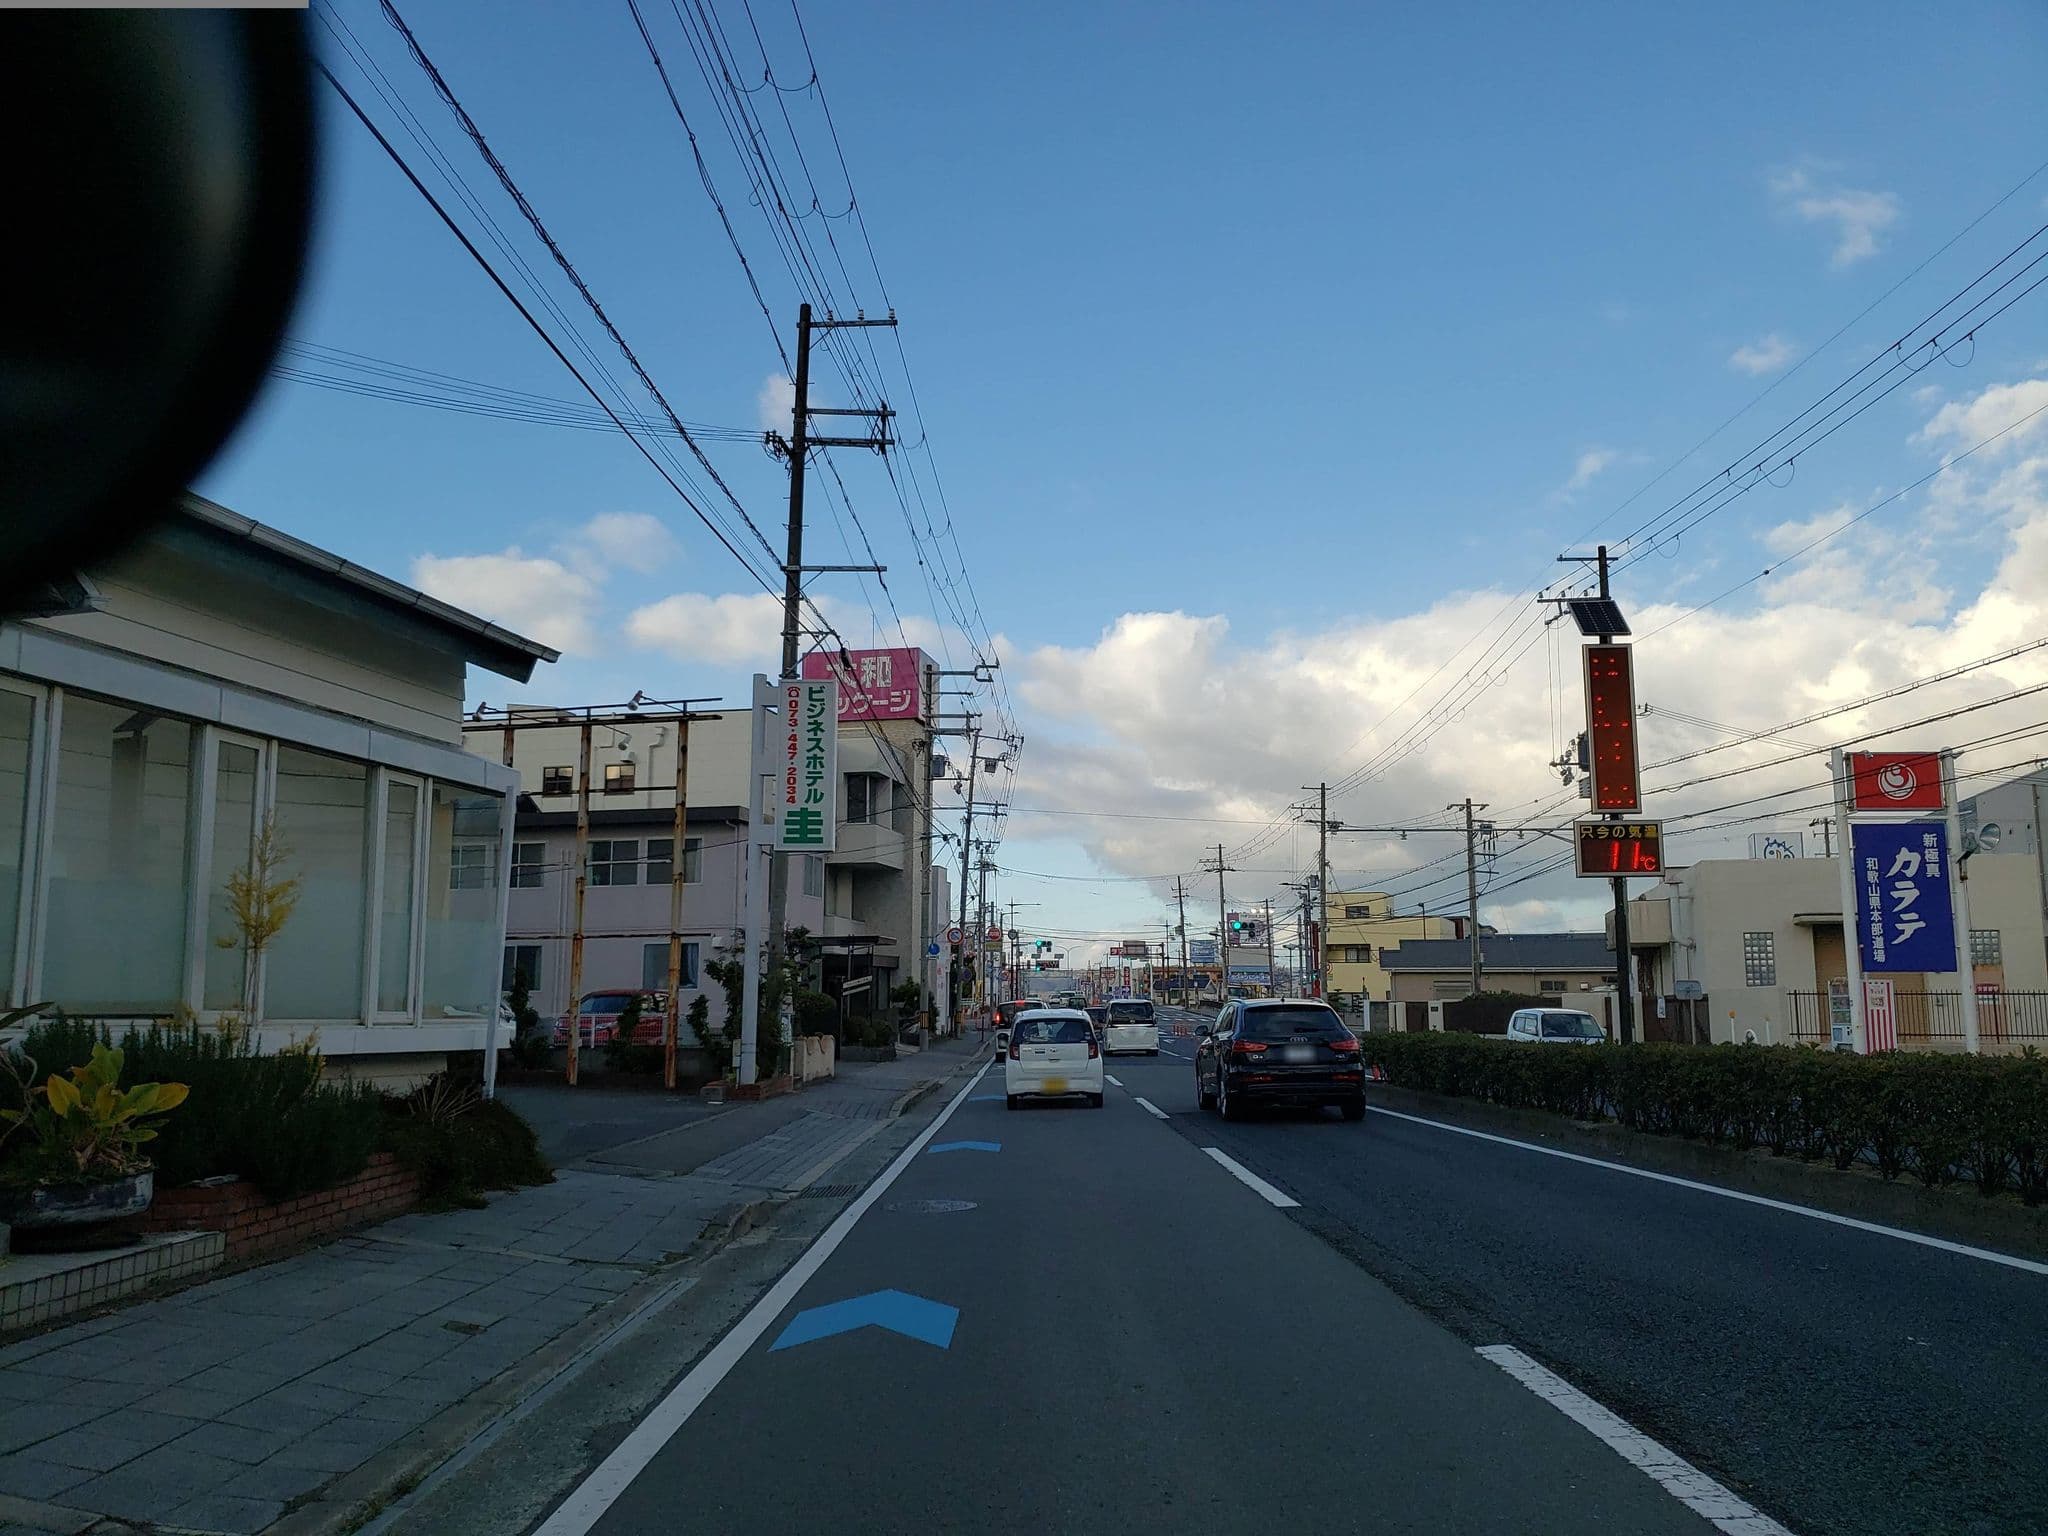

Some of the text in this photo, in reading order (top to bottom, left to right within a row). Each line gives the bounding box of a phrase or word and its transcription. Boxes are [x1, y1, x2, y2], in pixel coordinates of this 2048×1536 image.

[804, 686, 825, 804] ビジネスホテル
[783, 807, 824, 844] 圭
[1922, 833, 1941, 878] 新極真
[1866, 857, 1886, 963] 和歌山県本部道場
[1885, 847, 1926, 945] カラテ
